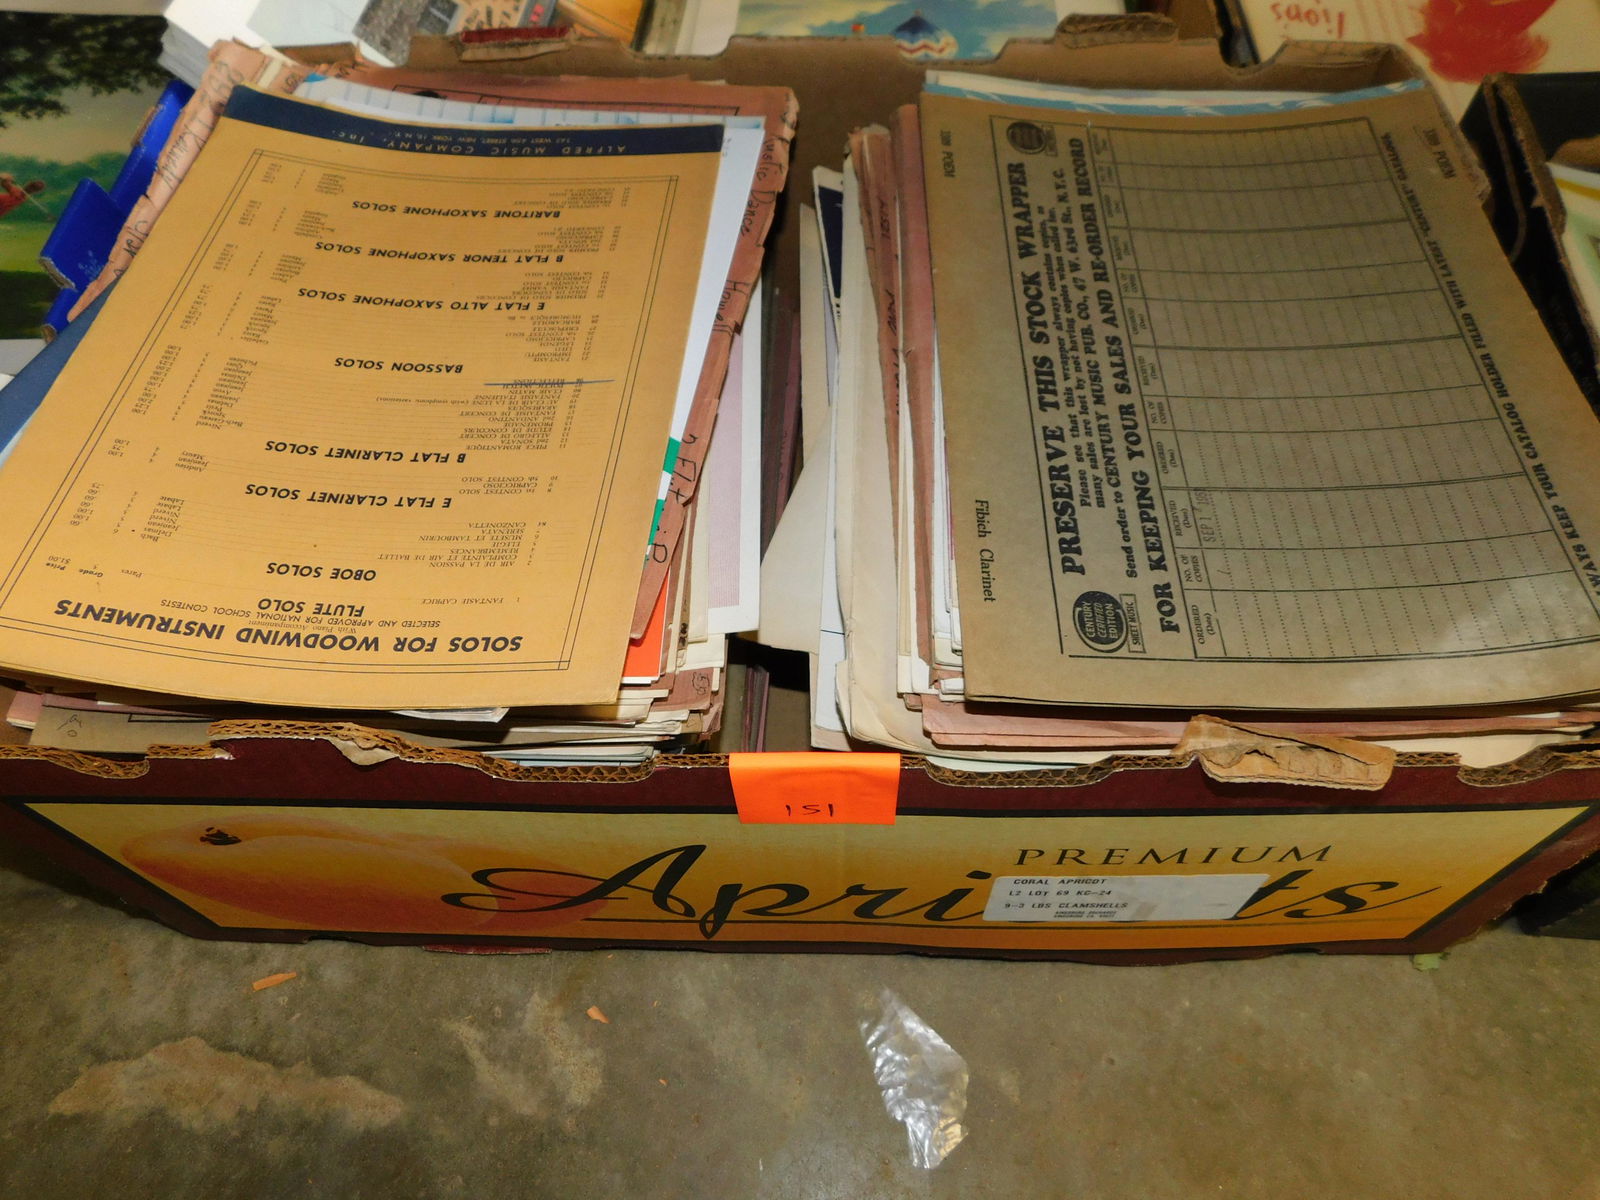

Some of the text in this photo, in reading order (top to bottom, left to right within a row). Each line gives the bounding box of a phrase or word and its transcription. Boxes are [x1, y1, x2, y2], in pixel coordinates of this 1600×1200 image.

[490, 146, 546, 155] MUSIC
[561, 145, 626, 155] ALFRED
[1068, 137, 1092, 197] RECORD
[352, 200, 561, 219] BARITONE SAXOPHONE SOLOS
[739, 190, 777, 236] Dance
[315, 241, 564, 263] B FLAT TENOR SAXOPHONE SOLOS
[1080, 202, 1110, 283] RE-ORDER
[1042, 253, 1057, 292] contains
[1054, 255, 1066, 281] when
[1068, 256, 1081, 273] W.
[1426, 239, 1453, 278] LATEST
[297, 288, 546, 311] E FLAT ALTO SAXOPHONE SOLOS
[1059, 284, 1073, 314] copies
[1072, 276, 1088, 292] 47
[1446, 280, 1468, 309] WITH
[1049, 296, 1065, 332] always
[1076, 296, 1091, 321] CO.,
[1096, 288, 1119, 329] AND
[1064, 318, 1079, 352] having
[1079, 324, 1097, 355] PUB.
[1461, 312, 1487, 349] FILLED
[334, 357, 464, 374] BASSOON SOLOS
[1007, 162, 1086, 576] PRESERVE THIS STOCK WRAPPER
[1055, 337, 1073, 381] wrapper
[1071, 355, 1083, 373] not
[1105, 335, 1132, 395] SALES
[1074, 376, 1086, 390] by
[1086, 359, 1106, 406] MUSIC
[1480, 353, 1511, 398] HOLDER
[1063, 387, 1075, 407] this
[1077, 395, 1090, 415] lost
[1067, 414, 1081, 438] that
[1084, 419, 1094, 437] are
[1117, 402, 1145, 461] YOUR
[1502, 402, 1538, 460] CATALOG
[264, 440, 467, 463] B FLAT CLARINET SOLOS
[1075, 445, 1085, 462] see
[1086, 441, 1099, 470] sales
[1094, 410, 1122, 488] CENTURY
[245, 484, 452, 508] E FLAT CLARINET SOLOS
[1077, 469, 1092, 507] Please
[1092, 474, 1106, 508] many
[1531, 462, 1559, 500] YOUR
[1112, 491, 1124, 504] to
[1113, 507, 1132, 543] order
[1131, 470, 1168, 572] KEEPING
[1551, 504, 1580, 540] KEEP
[974, 499, 996, 602] Fibich Clarinet
[1122, 546, 1139, 578] Send
[266, 562, 377, 581] OBOE SOLOS
[160, 599, 208, 613] CONTESTS
[213, 606, 250, 618] SCHOOL
[256, 611, 303, 623] NATIONAL
[258, 598, 365, 617] FLUTE SOLO
[305, 616, 323, 624] FOR
[1082, 600, 1096, 638] CENTURY
[1093, 602, 1107, 638] CERTIFIED
[1105, 603, 1119, 639] EDITION
[1151, 582, 1180, 633] FOR
[54, 599, 523, 653] SOLOS FOR WOODWIND INSTRUMENTS
[328, 617, 374, 627] APPROVED
[401, 620, 441, 628] SELECTED
[1125, 602, 1142, 646] SHEET MUSIC
[1191, 604, 1206, 645] ORDERED
[1013, 845, 1332, 866] PREMIUM
